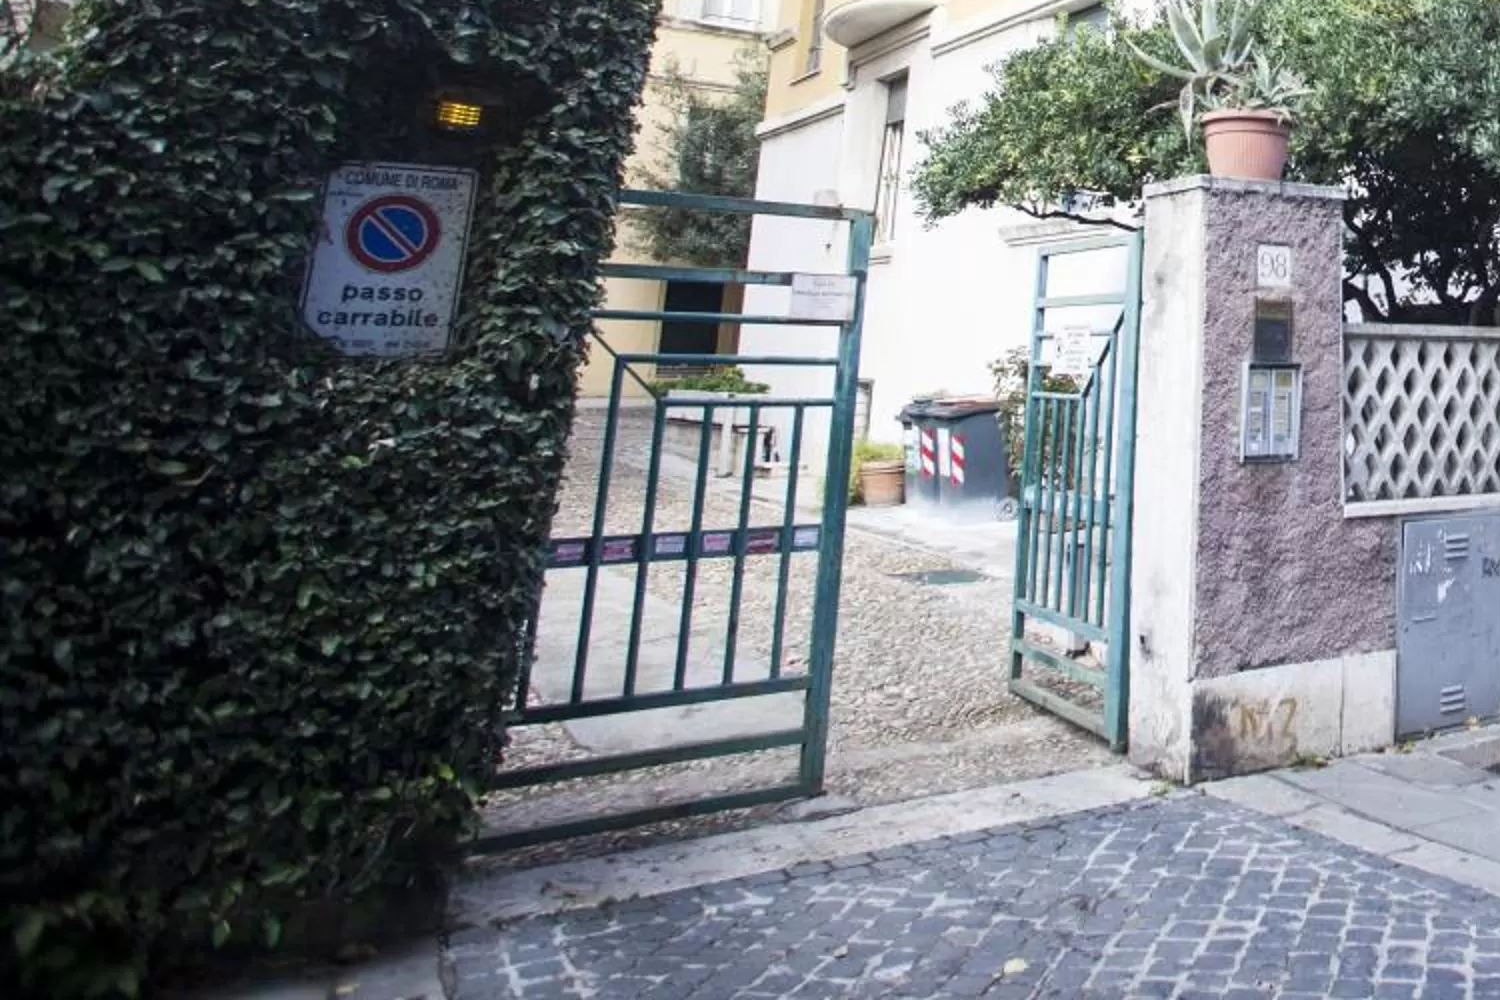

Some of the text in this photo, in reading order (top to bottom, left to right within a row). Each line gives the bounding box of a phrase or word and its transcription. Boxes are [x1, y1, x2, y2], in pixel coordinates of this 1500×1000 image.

[344, 171, 402, 187] COMUNE
[405, 173, 420, 190] DI
[1260, 252, 1288, 279] 98
[341, 284, 424, 302] passo
[317, 309, 438, 327] carrabile
